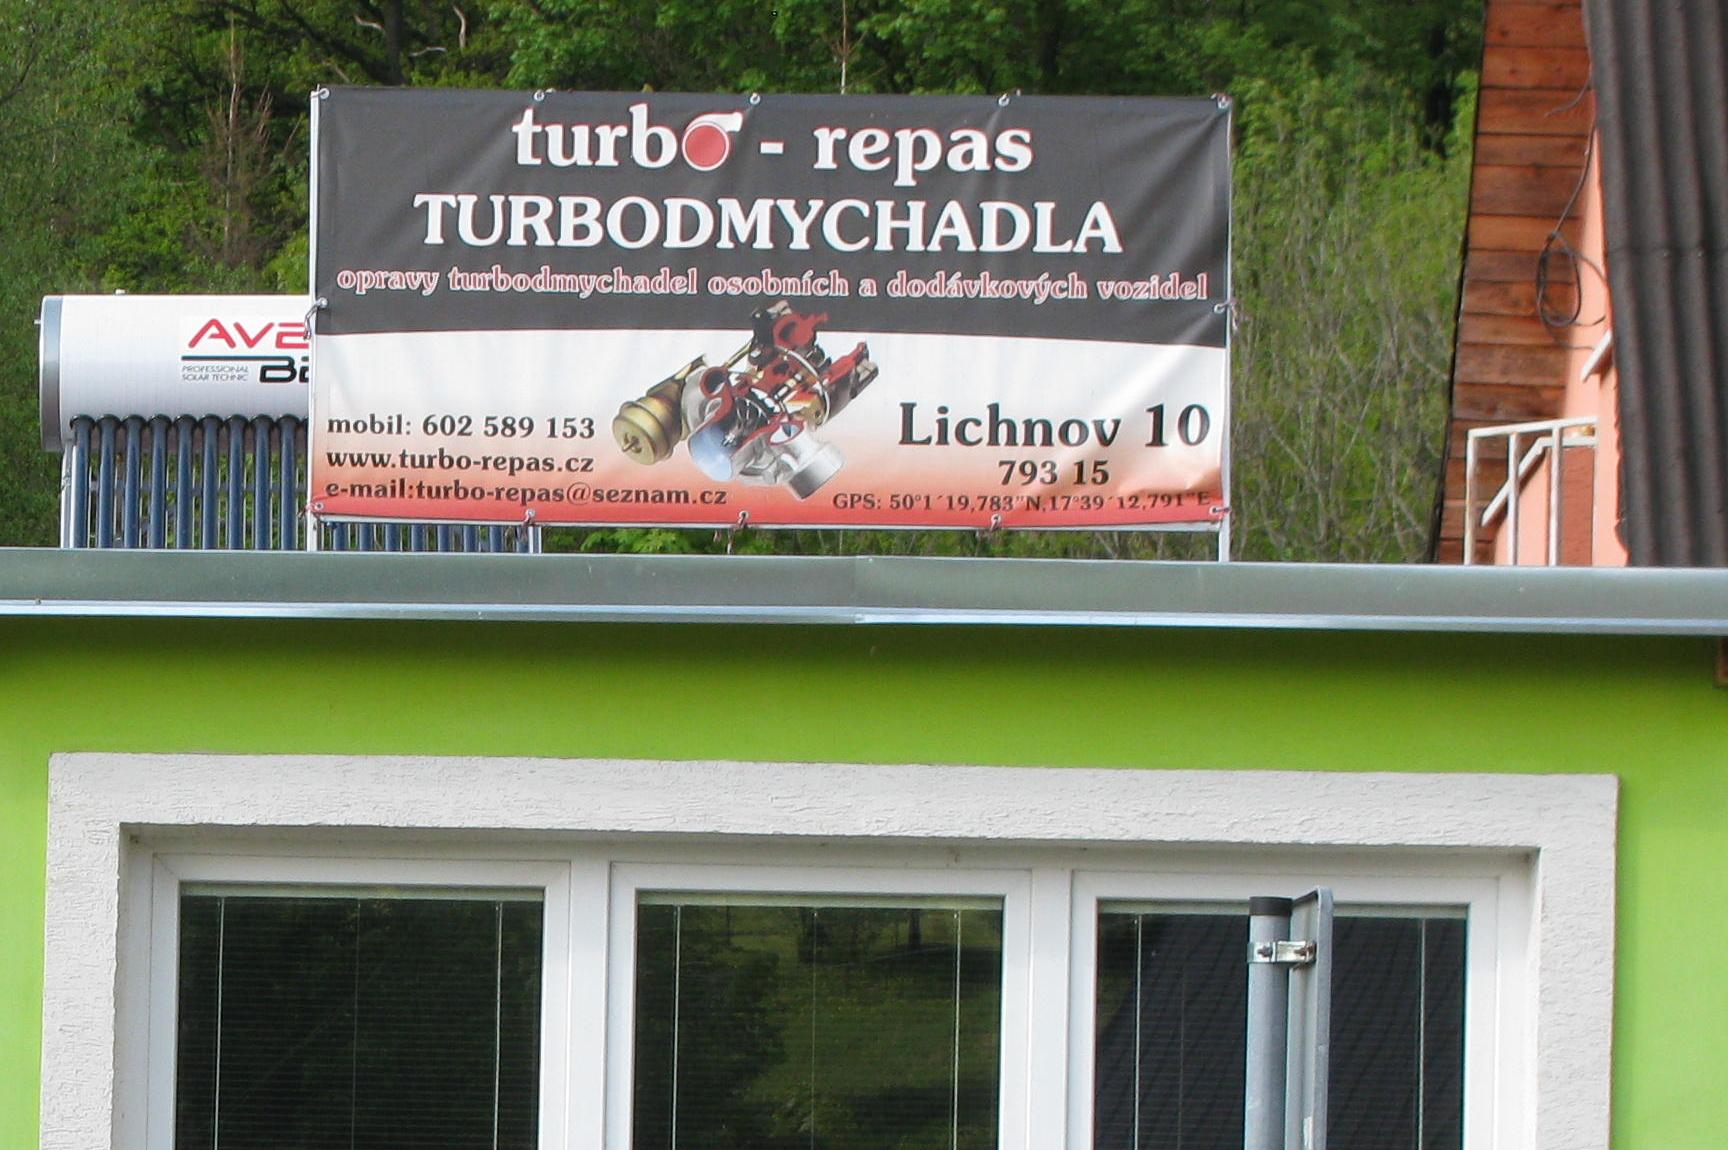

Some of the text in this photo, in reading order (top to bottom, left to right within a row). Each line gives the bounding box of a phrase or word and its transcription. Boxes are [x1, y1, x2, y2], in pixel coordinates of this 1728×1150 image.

[512, 103, 743, 171] turbo
[813, 127, 1032, 186] repas
[413, 193, 1123, 253] TURBODMYCHADLA
[337, 264, 1208, 304] opravy turbodmychadel osobních a dodávkových vozidel
[182, 373, 209, 381] SOLAR
[327, 414, 595, 439] mobil: 602 589 153
[899, 402, 1210, 447] Lichnov 10
[326, 448, 594, 476] www.turbo-repas.cz
[998, 460, 1109, 485] 793 15
[326, 480, 727, 506] e-mail:turbo-repas@seznam.cz
[833, 493, 881, 510] GPS:
